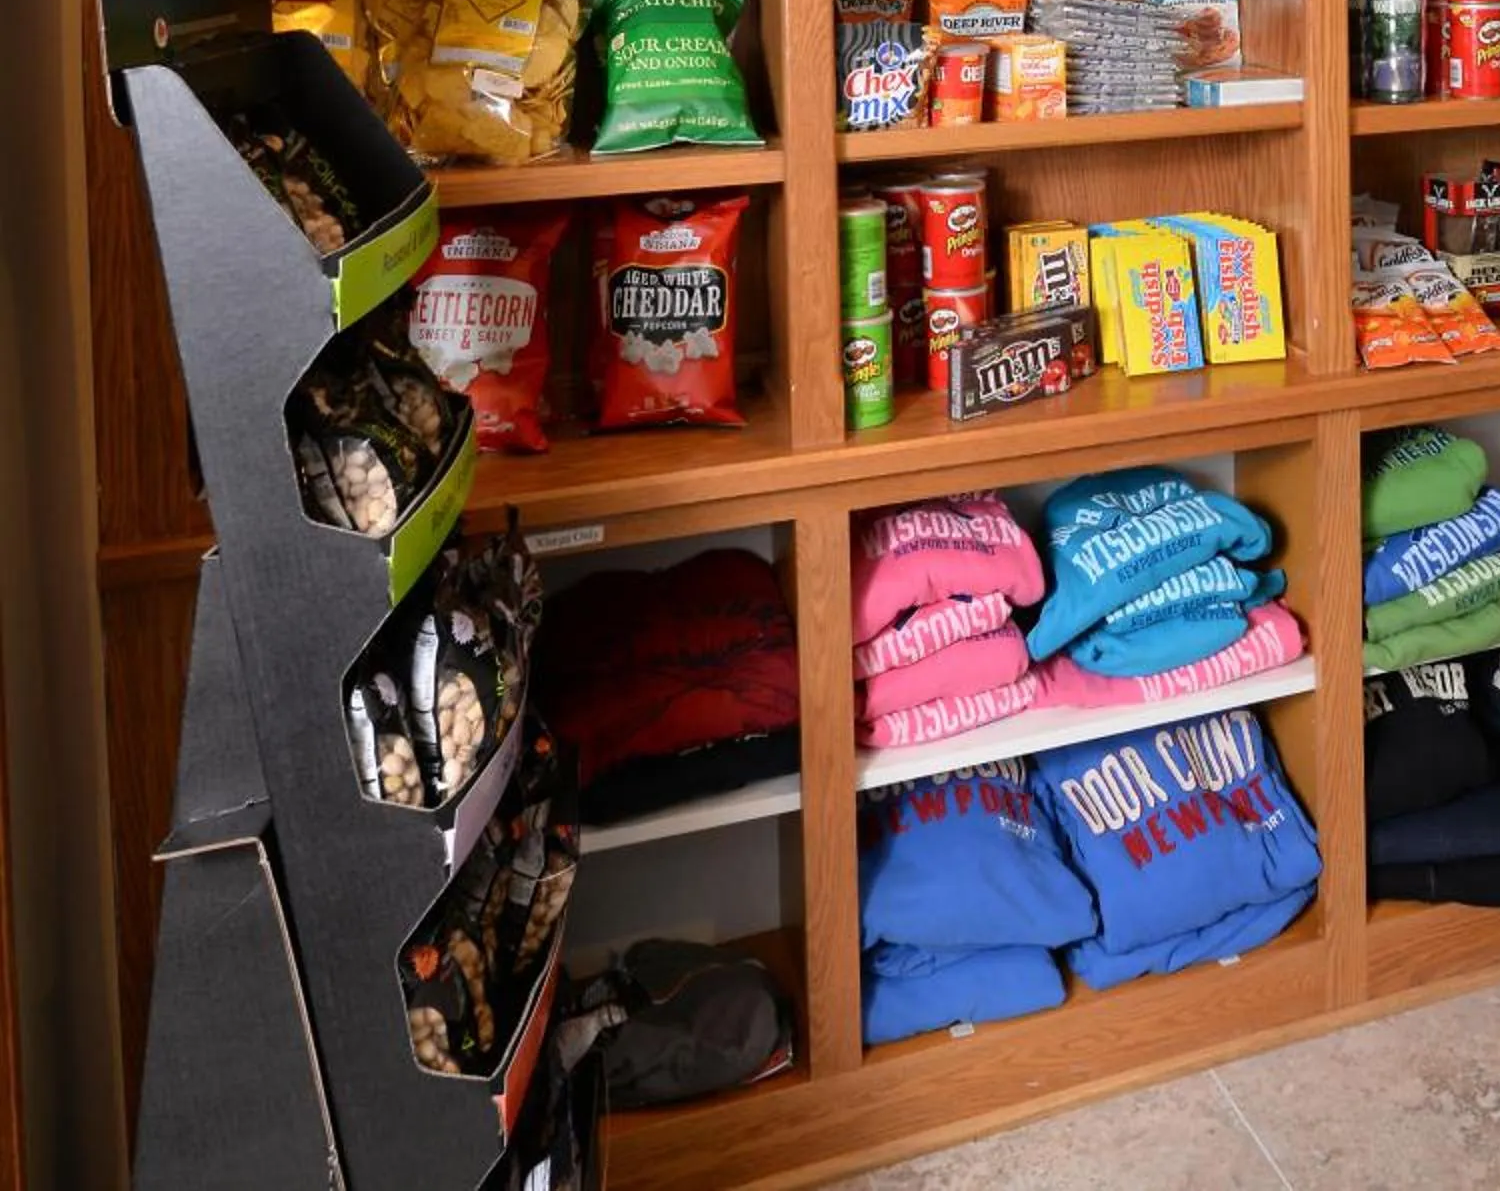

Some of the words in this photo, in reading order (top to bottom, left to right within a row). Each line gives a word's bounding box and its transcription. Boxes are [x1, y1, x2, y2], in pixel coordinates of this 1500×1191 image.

[943, 16, 979, 30] DEEP
[980, 15, 1021, 28] RIVER
[614, 37, 662, 67] SOUR
[665, 37, 732, 58] CREAM
[626, 57, 661, 71] AND
[664, 56, 719, 70] ONION
[845, 65, 915, 99] Chex
[623, 268, 660, 286] AGED
[663, 267, 710, 285] WHITE
[1217, 239, 1238, 293] Fish
[612, 285, 723, 320] CHEDDAR
[1237, 237, 1262, 342] Swedish
[418, 326, 457, 343] SWEET
[1140, 261, 1168, 368] Swedish
[1167, 309, 1190, 366] Fish
[862, 510, 1023, 559] WISCONSIN
[1072, 495, 1224, 586] WISCONSIN
[1060, 745, 1169, 836] DOOR
